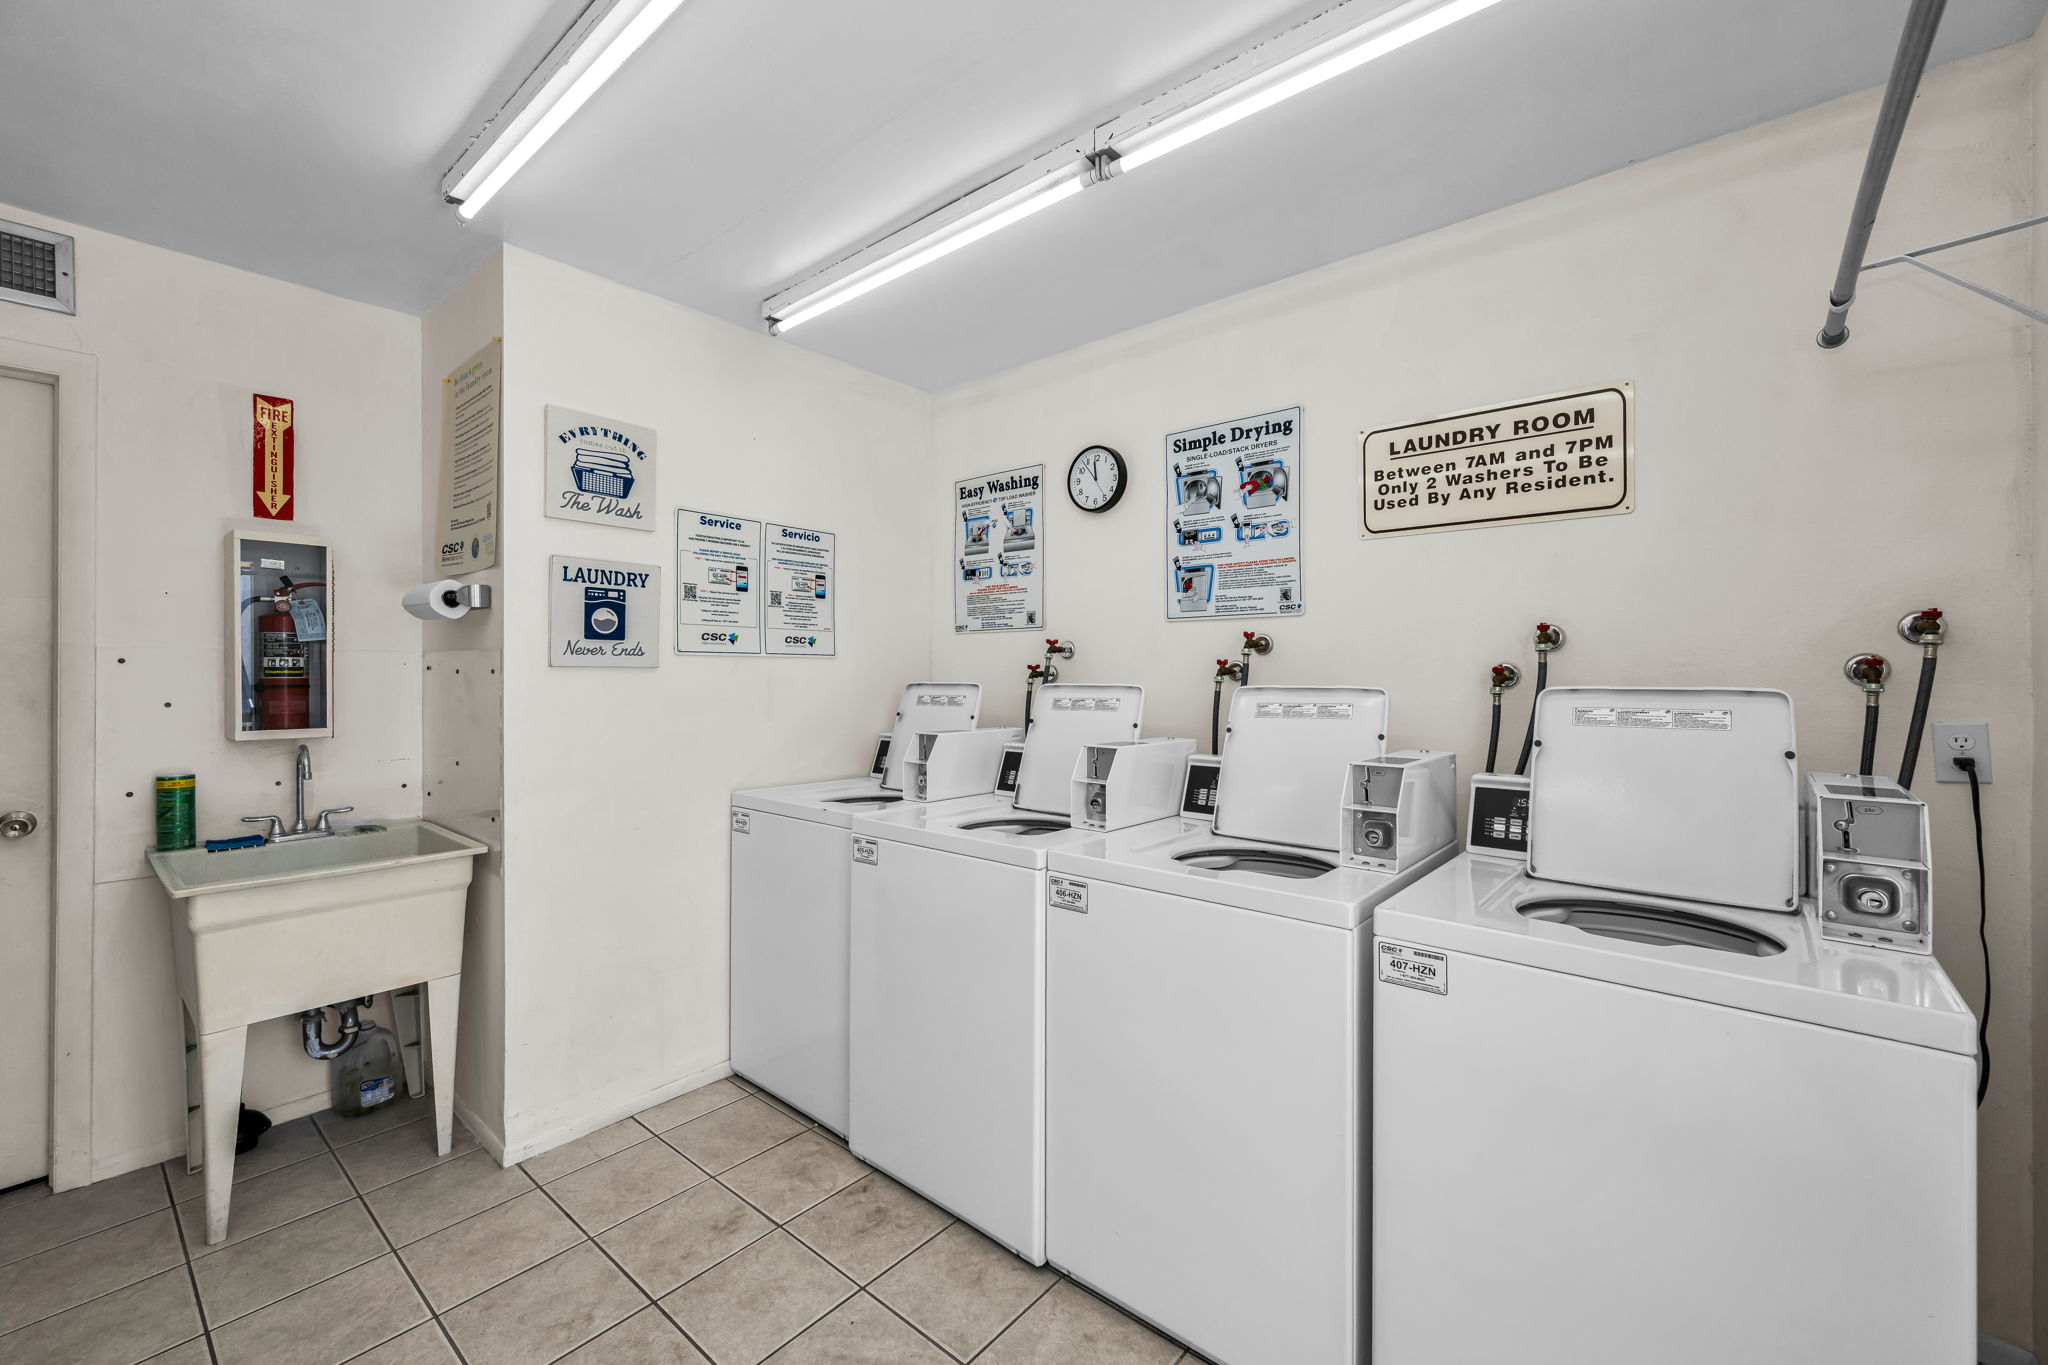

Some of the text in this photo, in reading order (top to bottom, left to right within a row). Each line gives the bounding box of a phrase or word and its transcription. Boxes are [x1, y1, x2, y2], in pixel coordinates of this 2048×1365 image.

[260, 407, 288, 422] FIRE
[1173, 431, 1226, 454] Simple
[1230, 420, 1293, 442] Drying
[1390, 407, 1596, 456] LAUNDRY ROOM
[558, 426, 646, 460] EVRYTHING
[580, 438, 602, 448] comes
[1186, 446, 1250, 462] SINGLE-LOAD/STACK
[1250, 440, 1278, 450] DRYERS
[270, 422, 278, 510] EXTINGUISHER
[1374, 434, 1614, 482] Between 7AM and 7PM
[960, 474, 1040, 500] Easy Washing
[1378, 456, 1608, 497] Only 2 Washers To Be
[1374, 470, 1614, 510] Used By Any Resident.
[560, 490, 642, 520] The Wash
[700, 516, 742, 530] Service
[782, 528, 820, 542] Servicio
[442, 542, 460, 554] CSC
[562, 566, 650, 588] LAUNDRY
[563, 640, 645, 656] Never Ends
[701, 632, 727, 642] CSC
[785, 636, 806, 644] CSC
[1056, 889, 1081, 900] 406-HZN
[1390, 960, 1436, 977] 407-HZN
